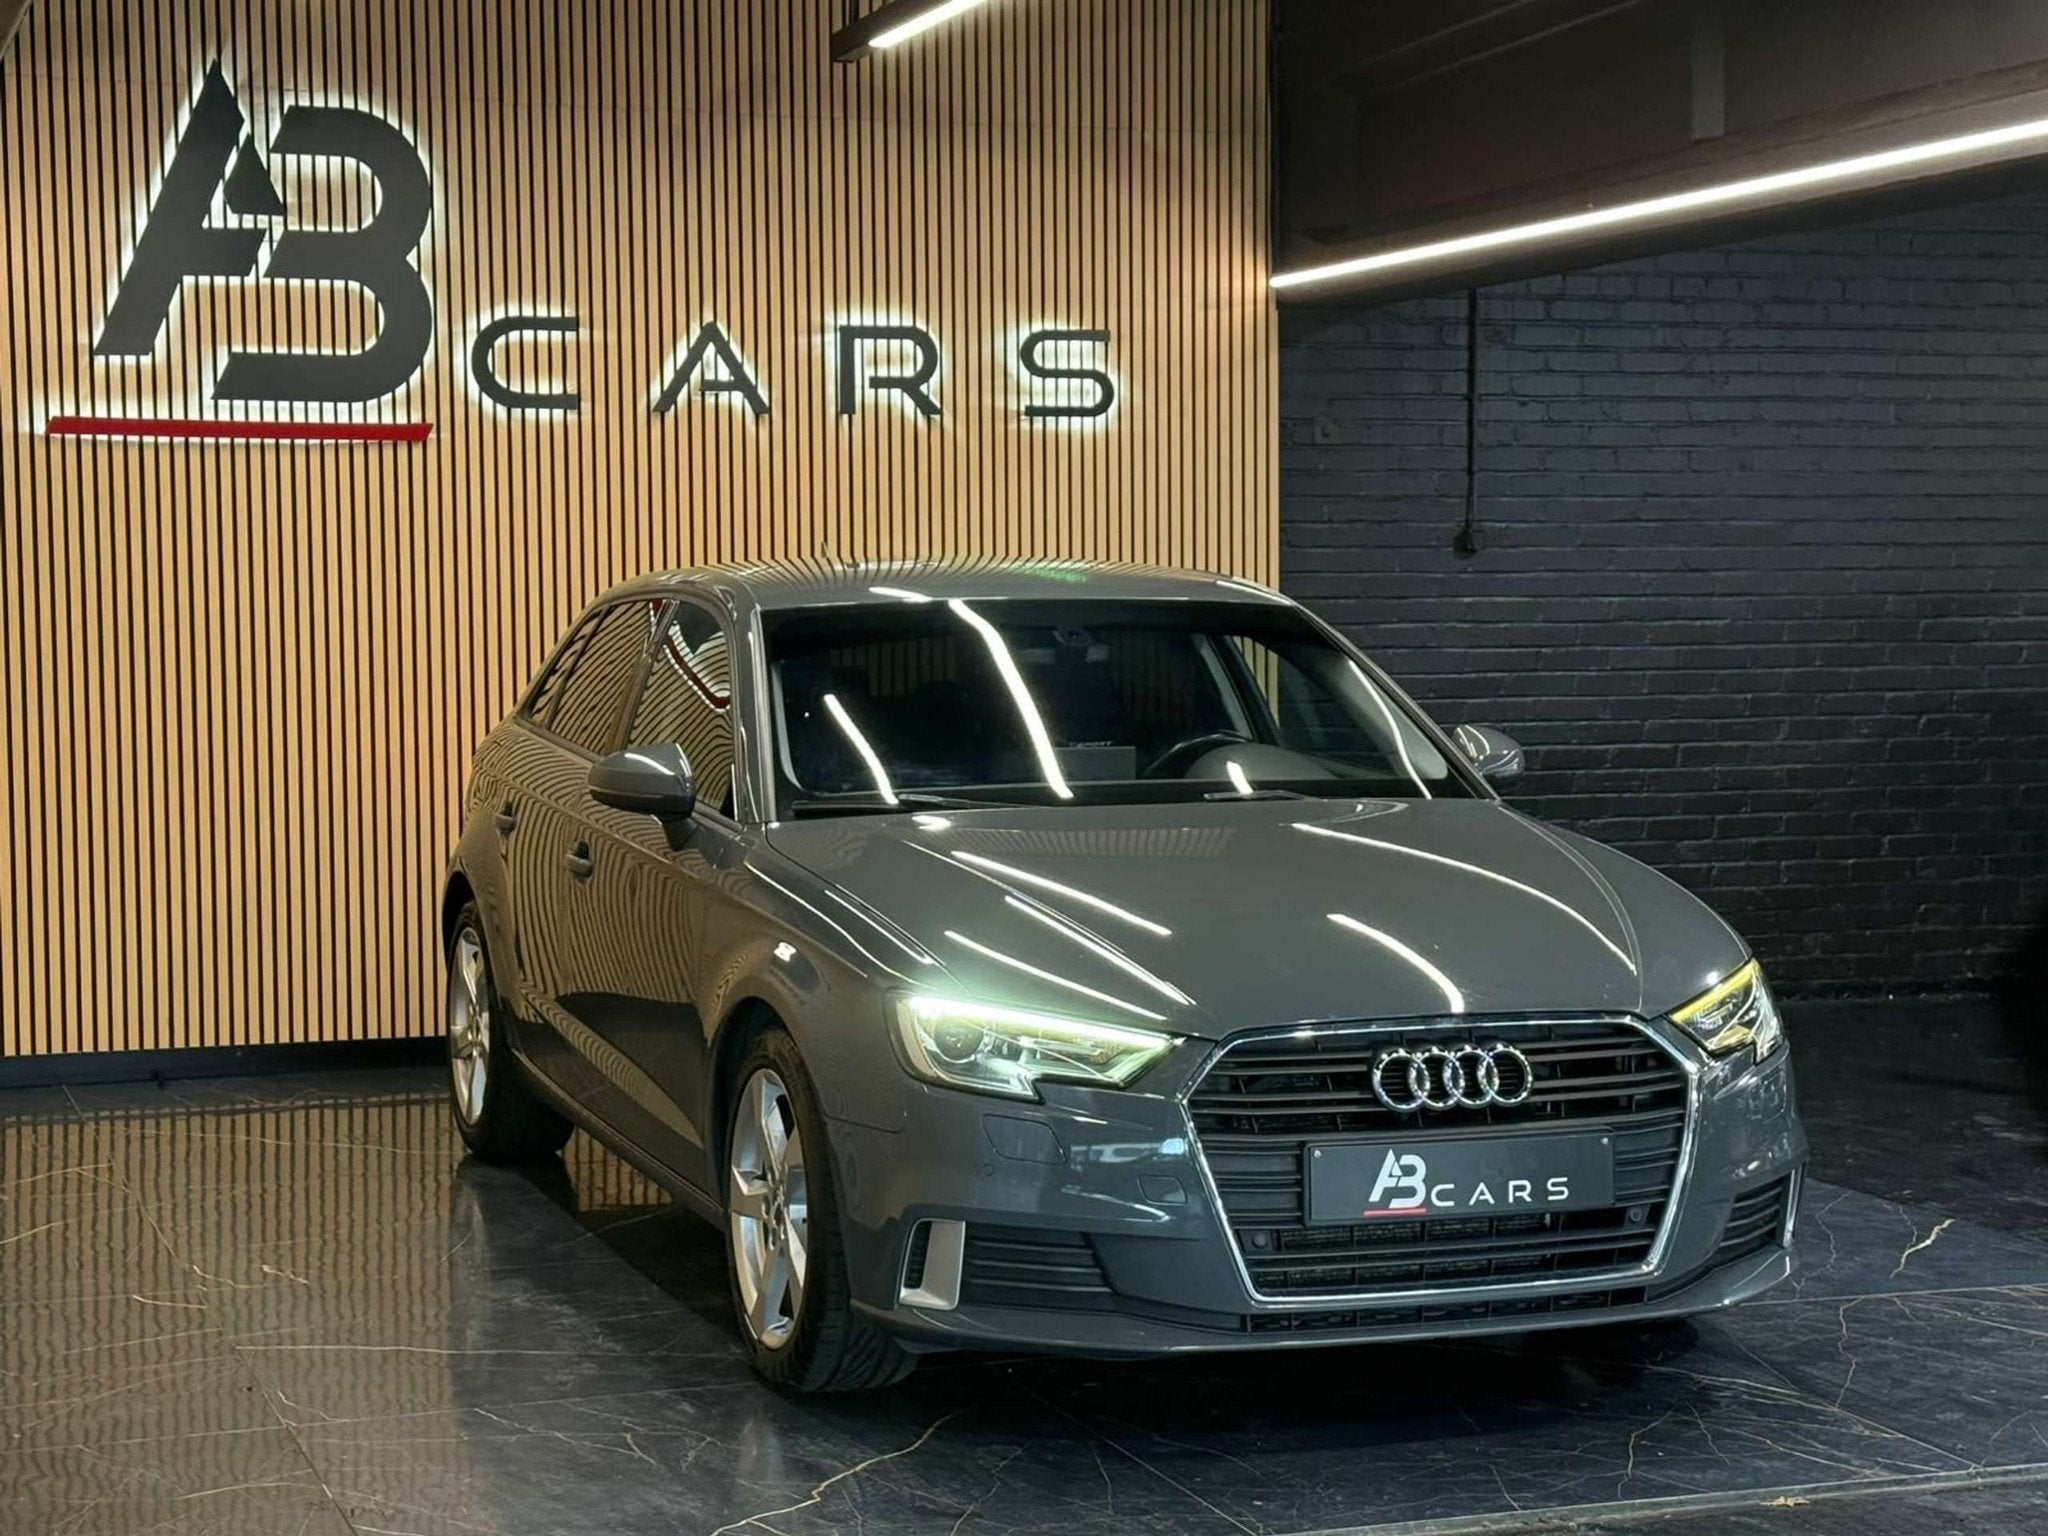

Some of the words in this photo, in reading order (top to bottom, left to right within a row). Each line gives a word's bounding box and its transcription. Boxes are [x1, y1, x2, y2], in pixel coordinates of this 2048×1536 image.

[93, 57, 432, 403] AB
[471, 314, 1115, 416] CARS
[1368, 1148, 1427, 1209] AB
[1430, 1177, 1569, 1207] CARS
